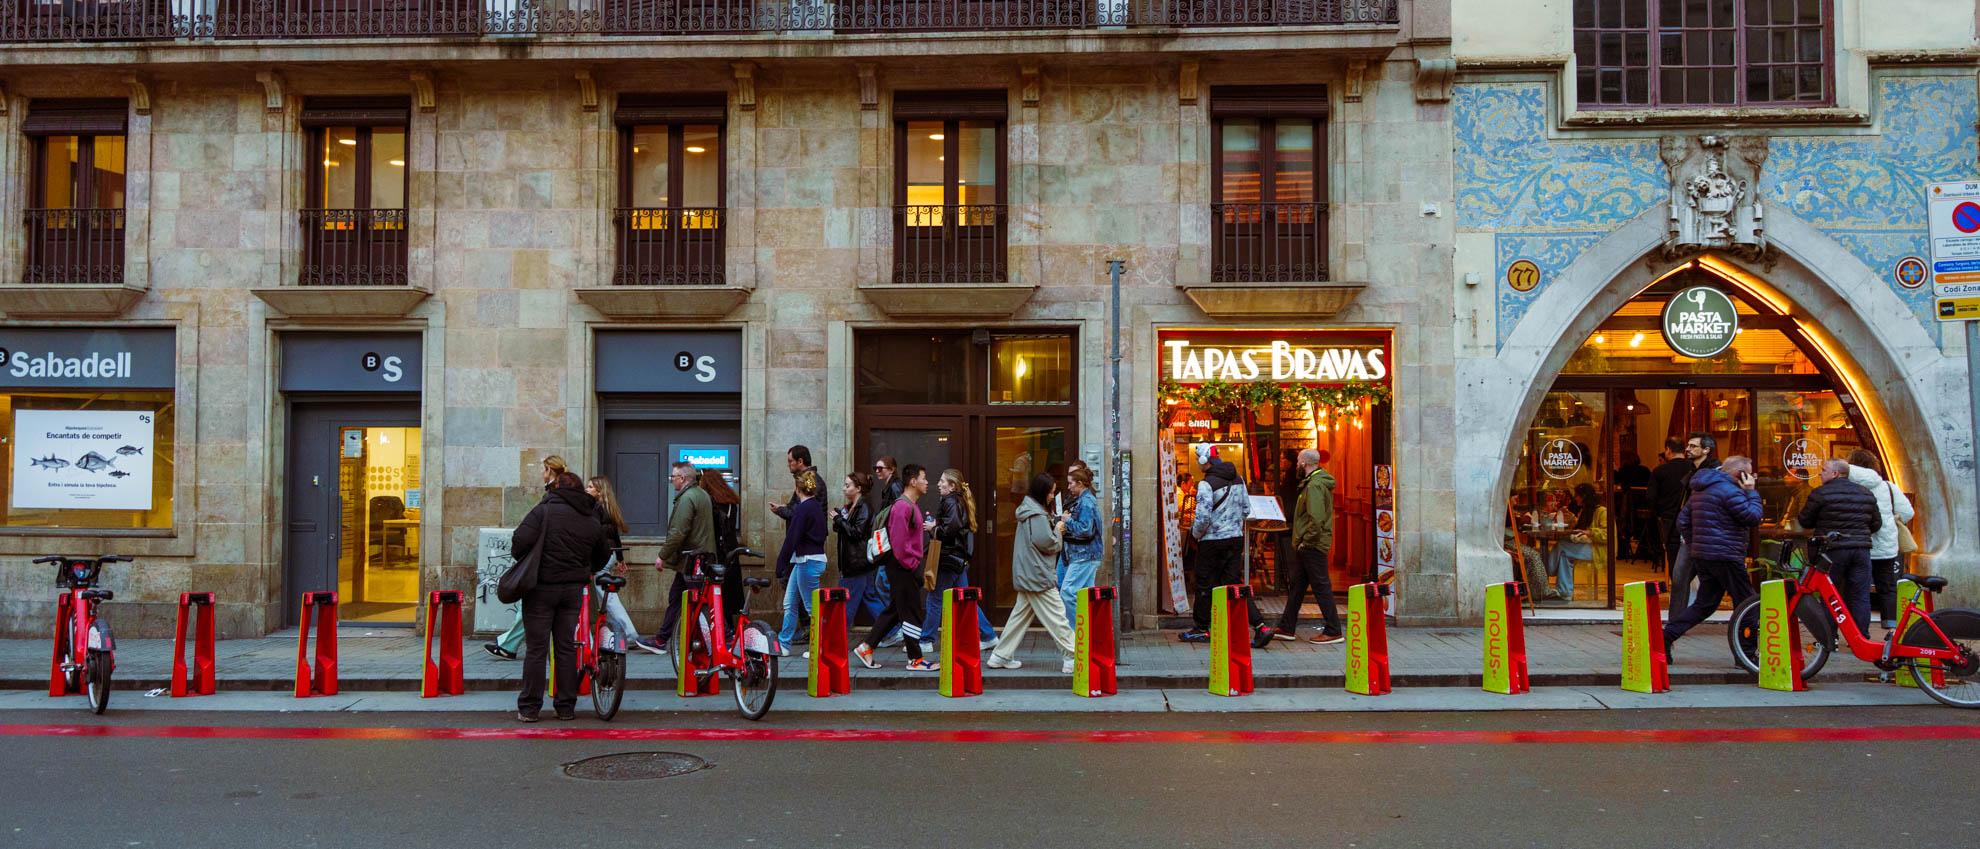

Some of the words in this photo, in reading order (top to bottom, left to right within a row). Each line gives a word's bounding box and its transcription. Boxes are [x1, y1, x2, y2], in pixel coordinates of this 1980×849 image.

[1512, 267, 1535, 287] 77
[1943, 285, 1961, 293] Codi
[1679, 311, 1723, 323] PASTA
[1671, 322, 1732, 334] MARKET
[10, 351, 132, 378] Sabadell
[1164, 340, 1260, 380] TAPAS
[1271, 340, 1387, 380] BRAVAS
[46, 432, 80, 440] Encantats
[82, 432, 91, 440] de
[92, 432, 122, 441] competir
[1627, 623, 1634, 634] ET
[1764, 607, 1781, 668] smou
[1076, 614, 1085, 673] smou
[1350, 610, 1361, 670] smou
[1488, 609, 1501, 670] smou
[1627, 635, 1635, 654] QUE
[1919, 648, 1936, 656] 2091
